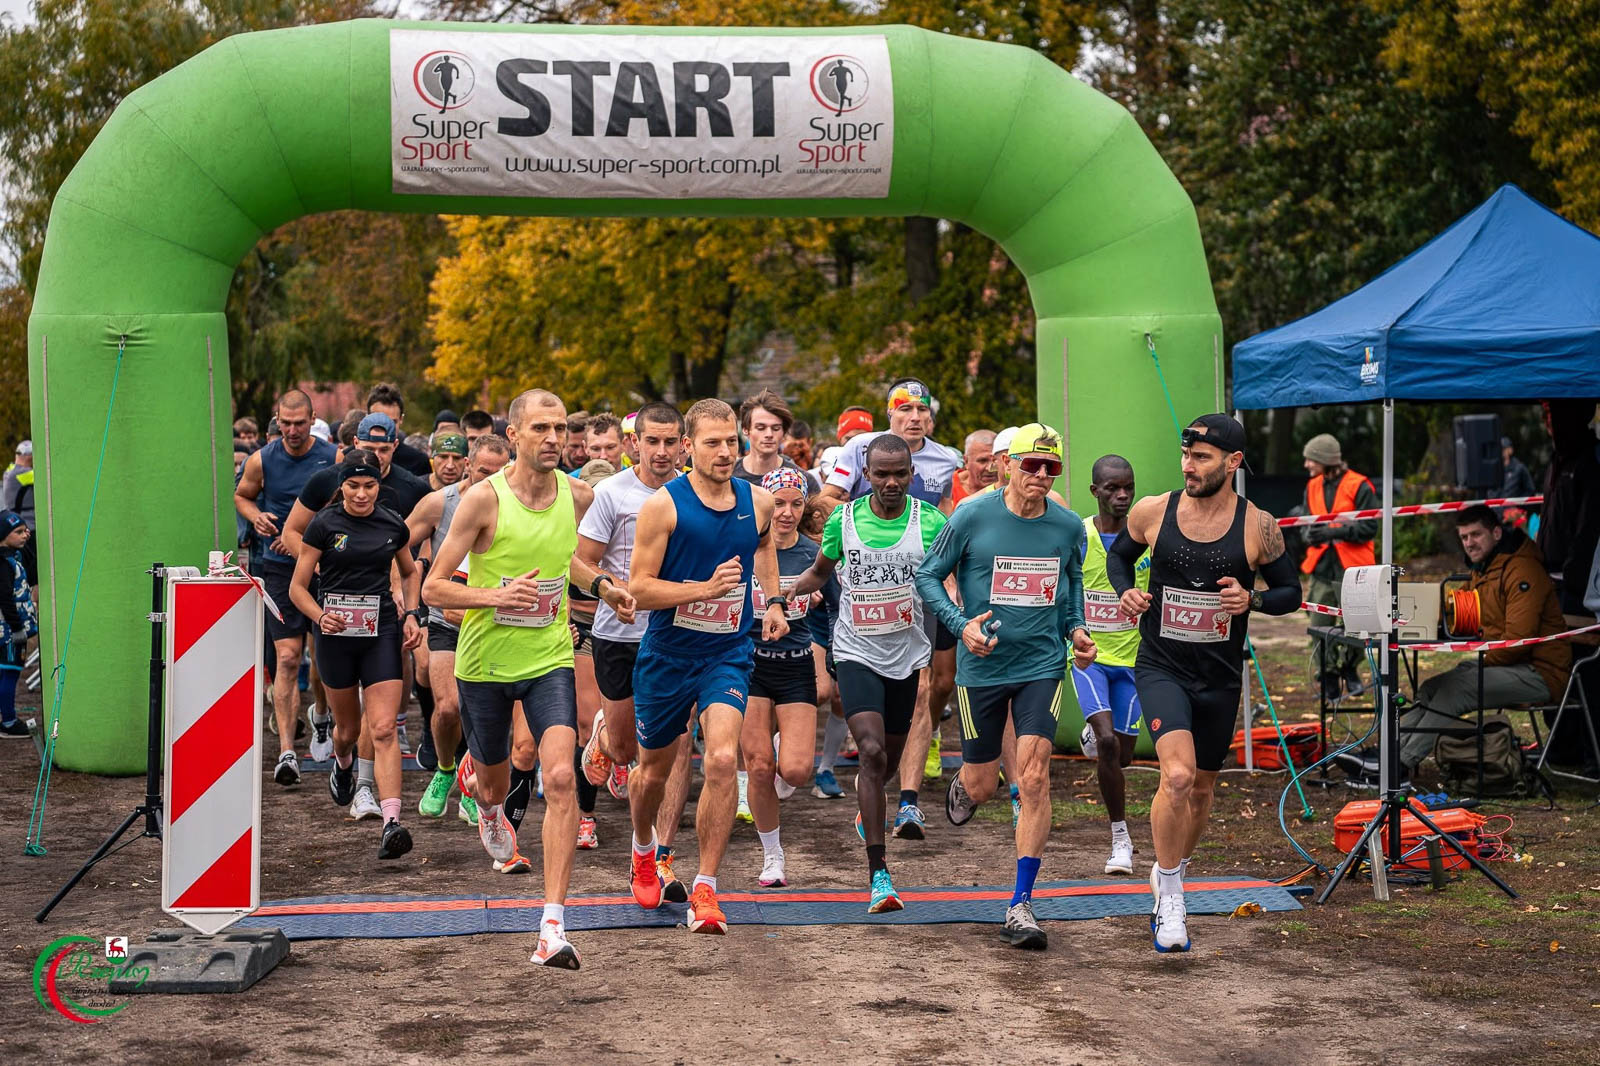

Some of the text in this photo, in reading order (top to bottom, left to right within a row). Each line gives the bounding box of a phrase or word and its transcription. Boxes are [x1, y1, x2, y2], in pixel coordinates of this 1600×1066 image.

[496, 58, 790, 137] START
[412, 113, 491, 144] Super
[810, 117, 884, 146] Super
[401, 136, 473, 167] Sport
[799, 139, 867, 168] Sport
[505, 154, 782, 178] www.super-sport.com.pl
[996, 561, 1012, 570] VIII
[849, 563, 915, 586] 悟空战队
[1002, 576, 1028, 590] 45
[327, 598, 338, 606] VIII
[851, 592, 866, 602] VIII
[1086, 593, 1100, 602] VIII
[1165, 592, 1181, 603] VIII
[686, 601, 719, 617] 127
[858, 606, 886, 621] 141
[1089, 605, 1118, 619] 142
[1168, 607, 1203, 626] 147
